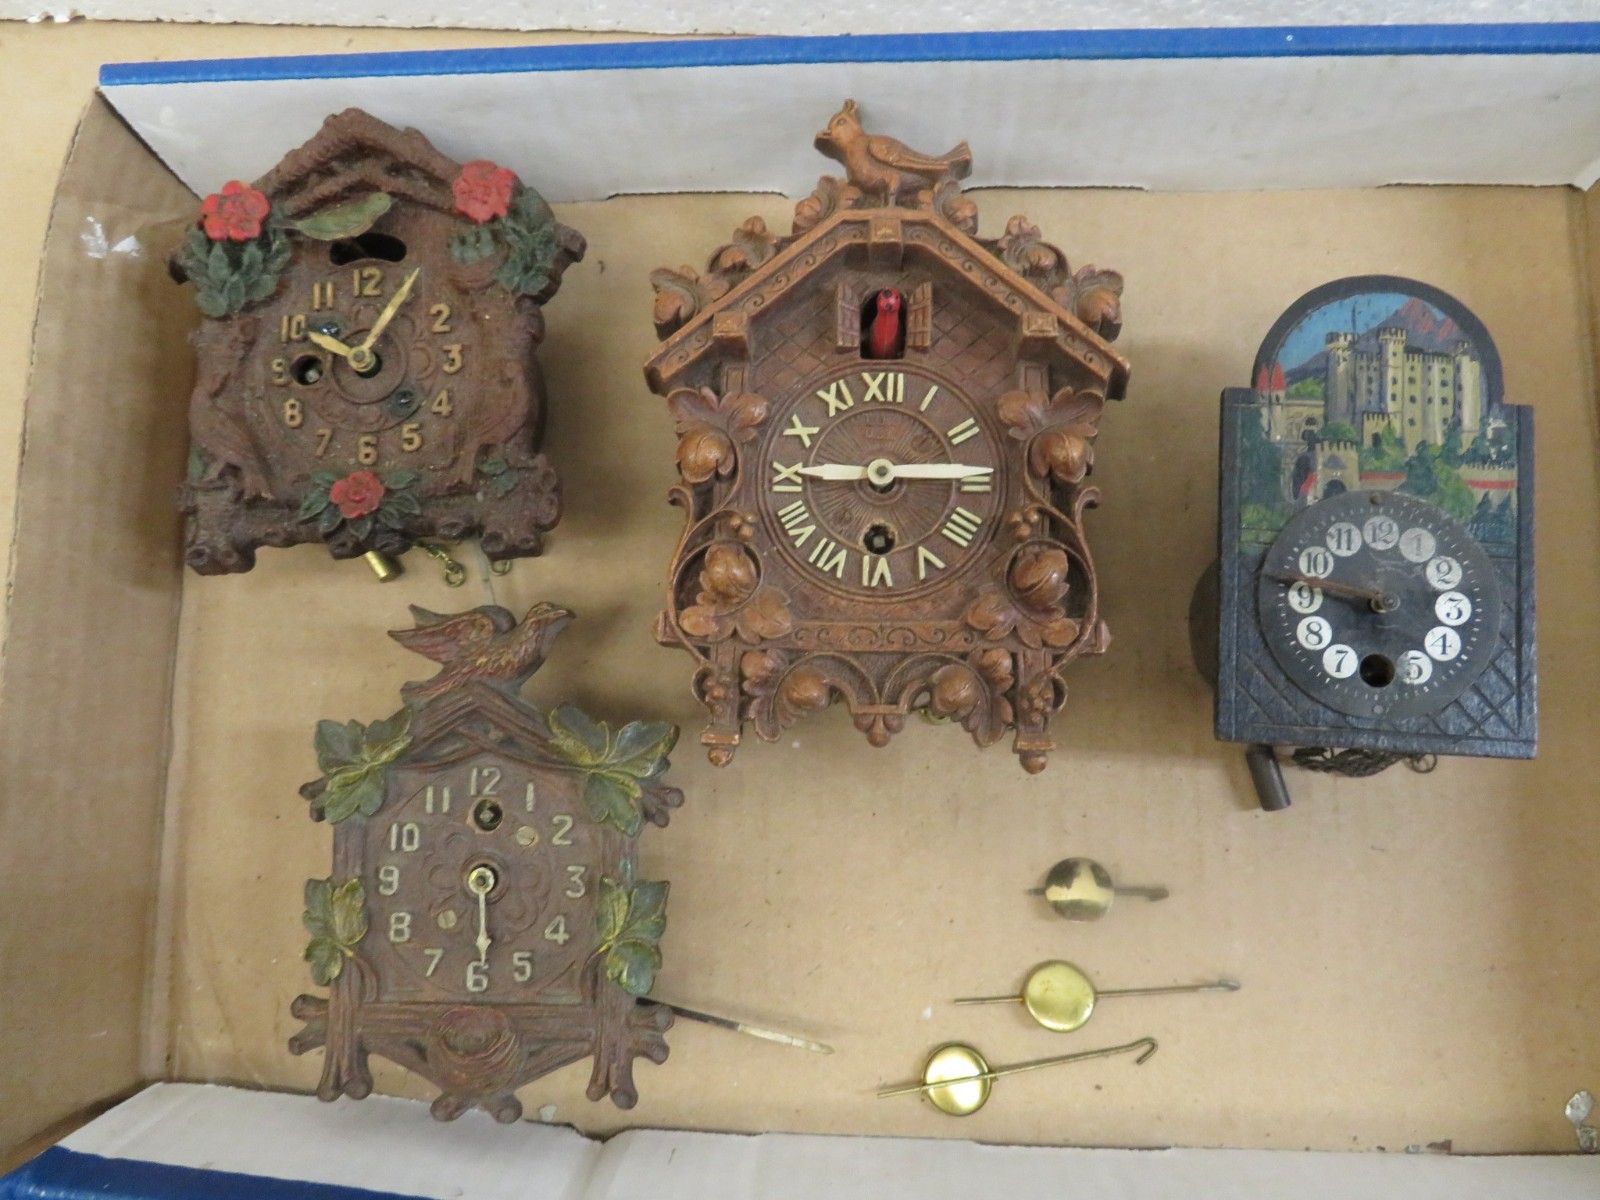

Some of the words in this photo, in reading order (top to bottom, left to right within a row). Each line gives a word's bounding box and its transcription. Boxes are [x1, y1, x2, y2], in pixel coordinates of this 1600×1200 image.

[313, 282, 334, 310] 11
[353, 267, 382, 296] 12
[281, 314, 307, 341] 10
[430, 304, 450, 333] 2
[443, 344, 463, 373] 3
[816, 380, 854, 417] XI
[862, 373, 903, 402] XII
[284, 399, 302, 427] 8
[432, 389, 452, 416] 4
[316, 429, 332, 457] 7
[402, 423, 422, 451] 5
[783, 415, 820, 448] X
[947, 417, 979, 445] II
[358, 435, 378, 465] 6
[772, 462, 802, 492] IX
[778, 500, 816, 548] VIII
[942, 507, 982, 547] IIII
[809, 538, 847, 578] VII
[863, 556, 893, 587] VI
[918, 546, 946, 579] V
[470, 768, 501, 796] 12
[426, 786, 449, 813] 11
[526, 782, 534, 812] 1
[390, 823, 419, 851] 10
[552, 815, 573, 845] 2
[379, 866, 399, 896] 9
[566, 866, 585, 897] 3
[390, 912, 411, 942] 8
[544, 915, 569, 944] 4
[425, 949, 443, 977] 7
[466, 962, 489, 992] 6
[513, 952, 532, 982] 5
